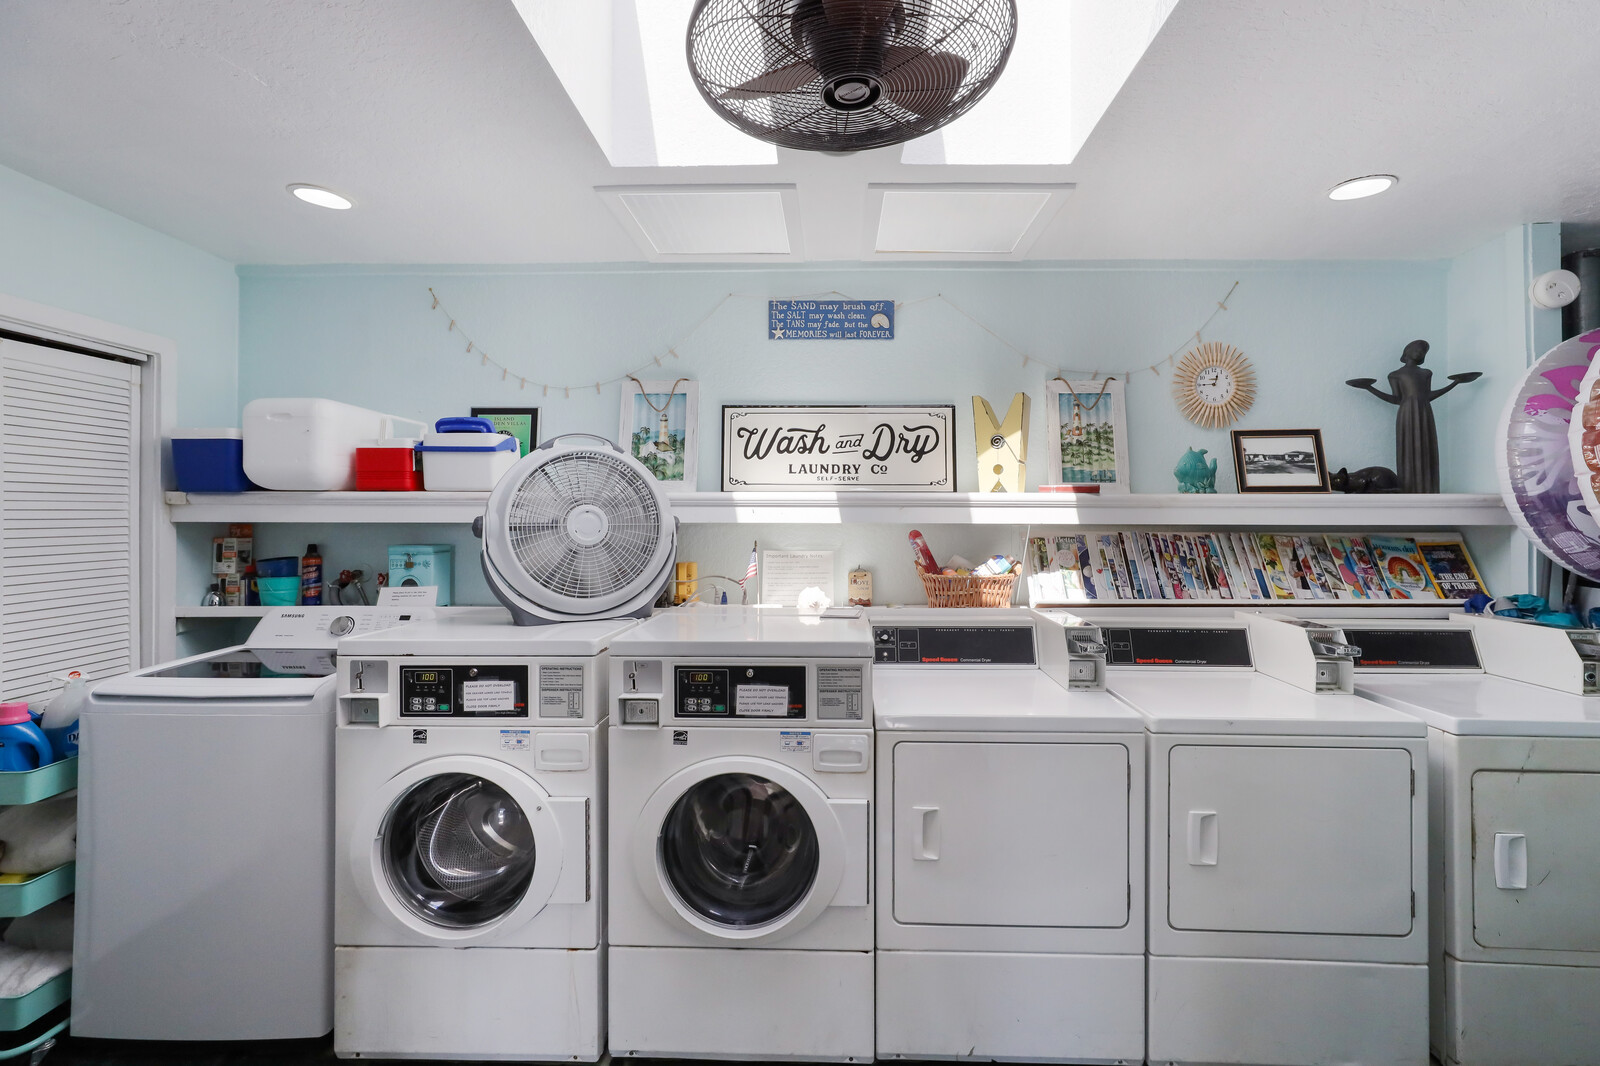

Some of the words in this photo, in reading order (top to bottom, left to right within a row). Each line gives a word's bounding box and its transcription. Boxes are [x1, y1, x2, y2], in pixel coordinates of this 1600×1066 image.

[771, 301, 787, 310] The
[791, 302, 816, 310] SAND
[820, 304, 839, 312] may
[771, 311, 784, 319] The
[809, 313, 824, 321] may
[737, 423, 830, 460] Wash
[833, 434, 864, 451] and
[862, 423, 939, 463] Dry
[789, 464, 861, 474] LAUNDRY
